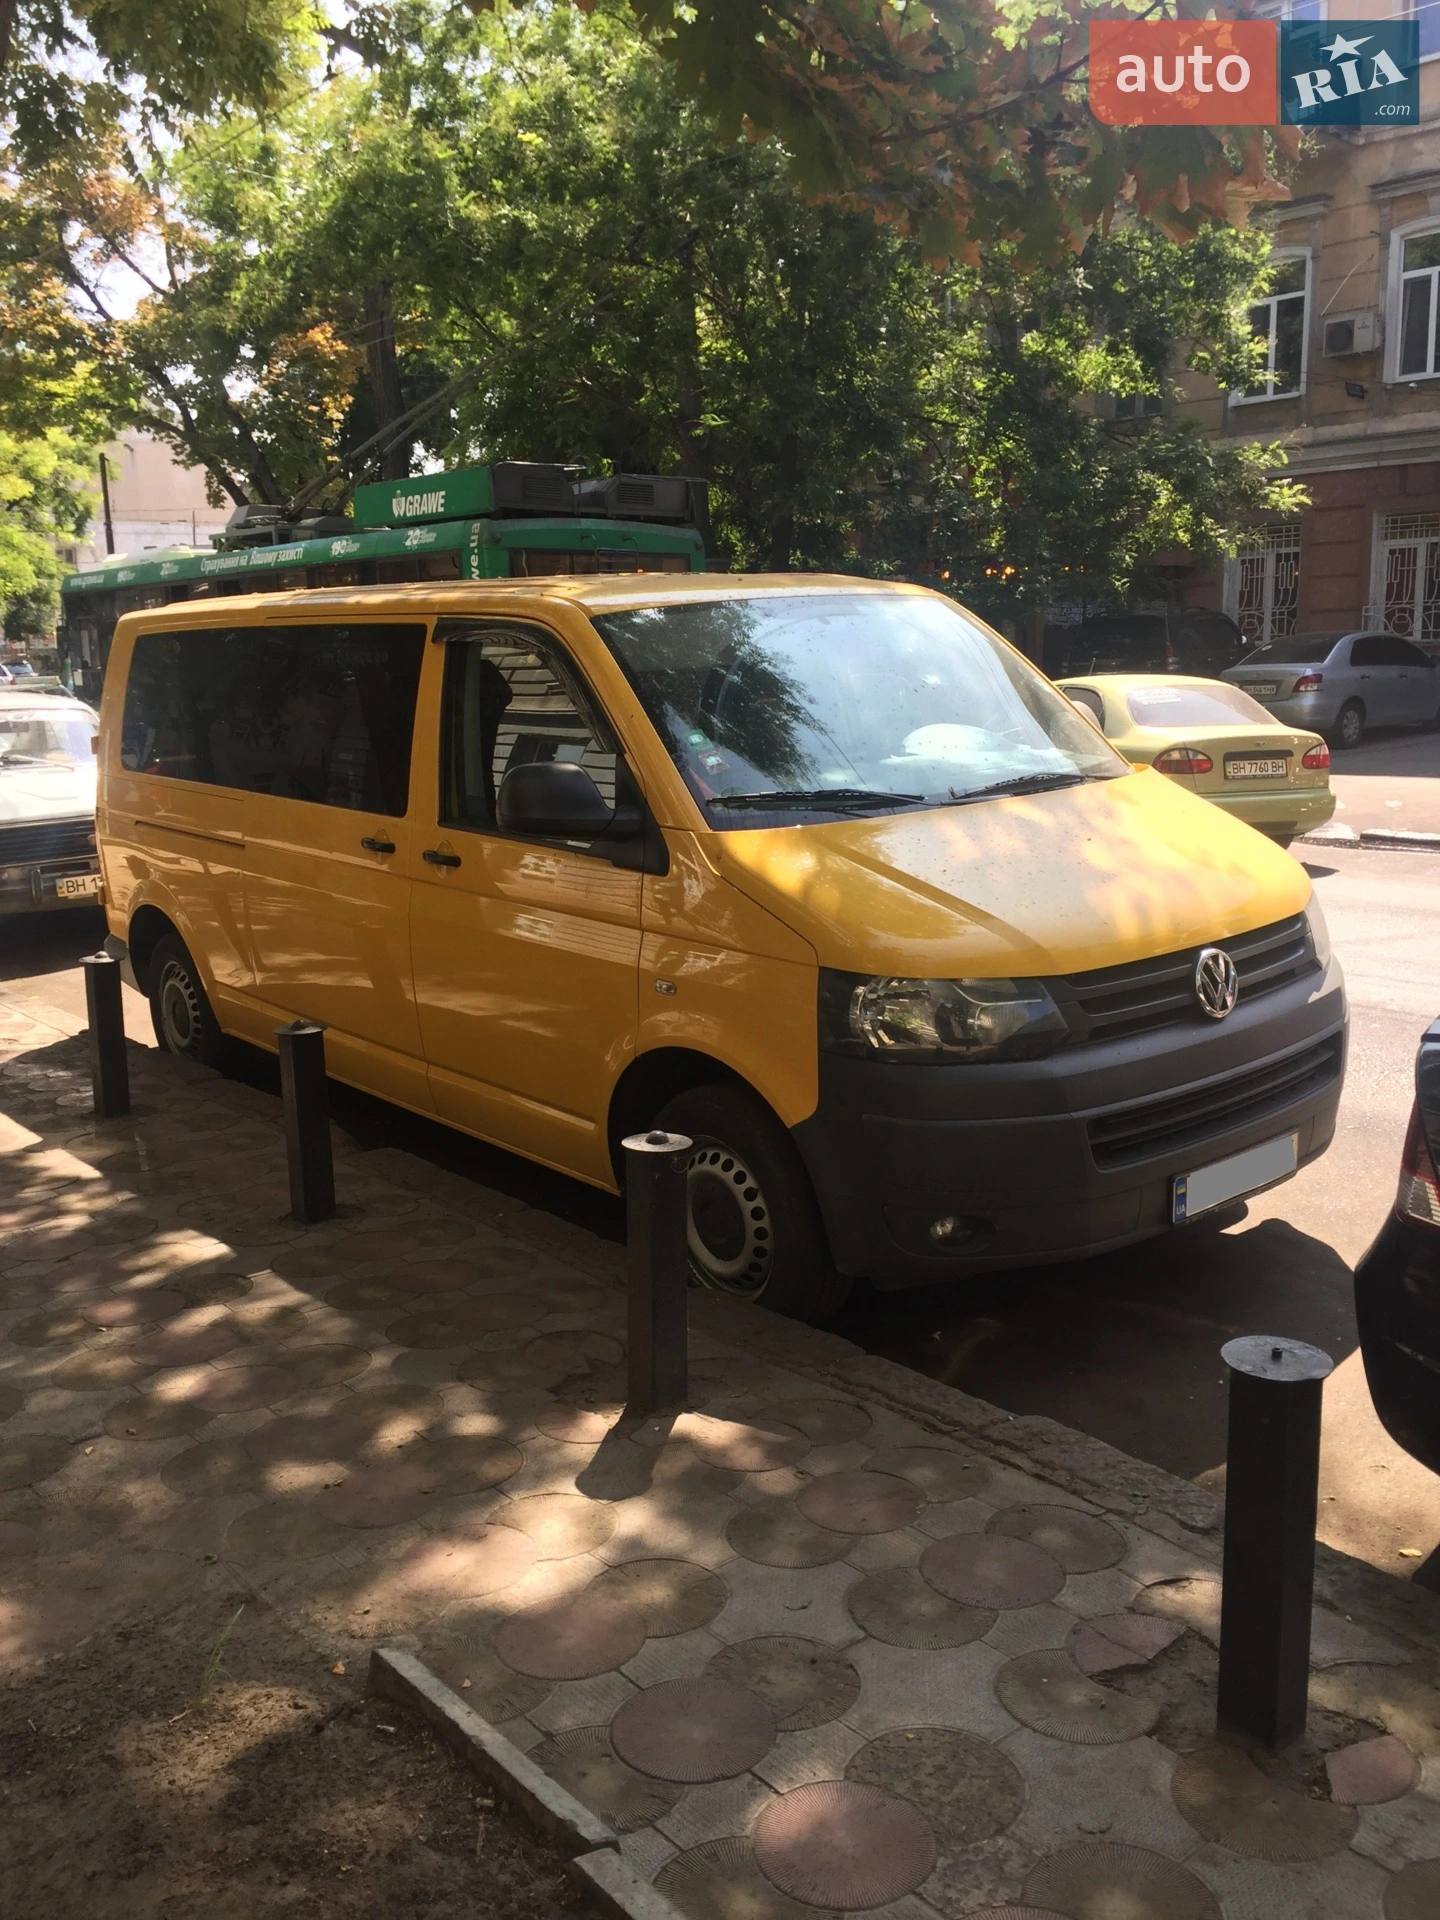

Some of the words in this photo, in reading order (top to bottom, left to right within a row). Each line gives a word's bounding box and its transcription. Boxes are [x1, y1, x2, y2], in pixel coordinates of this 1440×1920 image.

[405, 490, 446, 517] GRAWE
[1232, 762, 1246, 774] BH
[1247, 762, 1269, 773] 7760
[1271, 761, 1285, 773] BH
[65, 878, 87, 894] BH
[1176, 1203, 1186, 1215] UA
